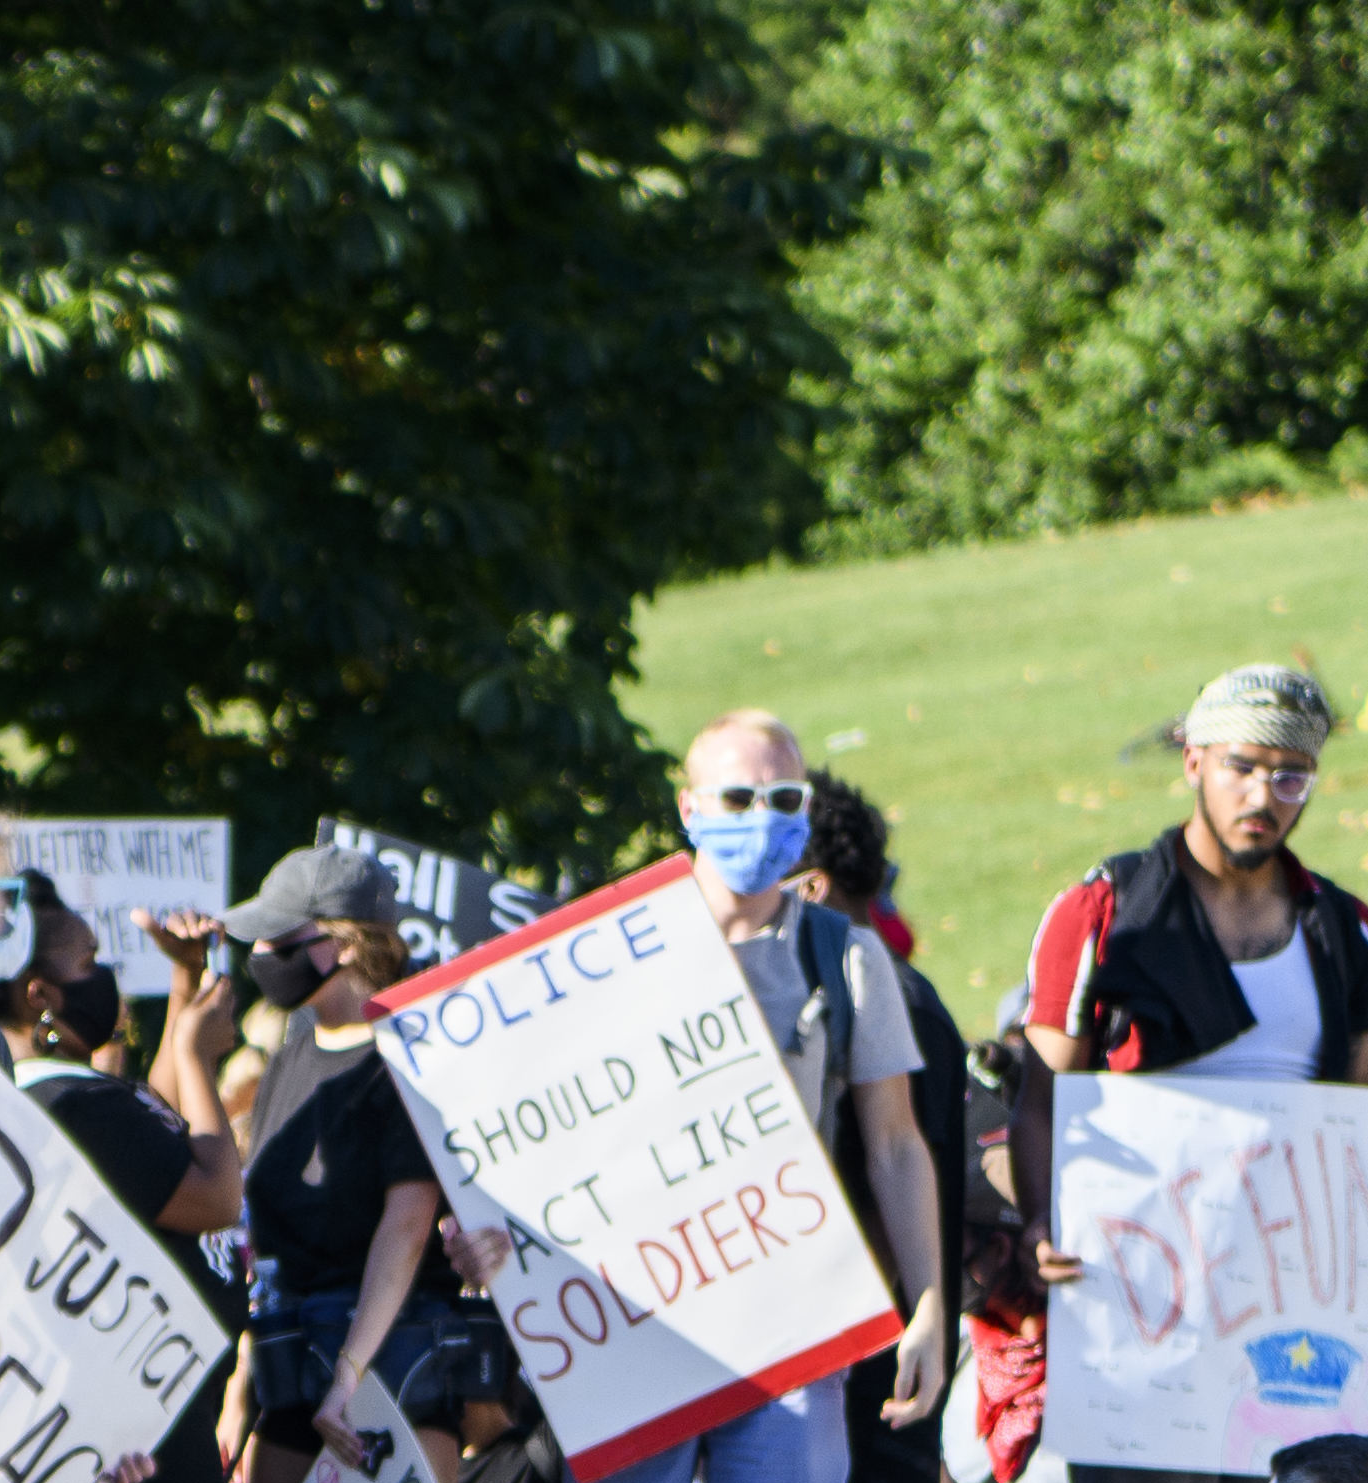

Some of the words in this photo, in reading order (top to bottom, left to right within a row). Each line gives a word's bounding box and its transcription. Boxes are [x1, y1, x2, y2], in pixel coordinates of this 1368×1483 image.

[390, 905, 666, 1077] POLICE
[443, 1057, 636, 1187] SHOULD
[657, 994, 750, 1079] NOT
[504, 1174, 613, 1274] ACT
[649, 1083, 791, 1187] LIKE
[25, 1207, 207, 1416] JUSTICE
[512, 1161, 827, 1383] SOLDIERS
